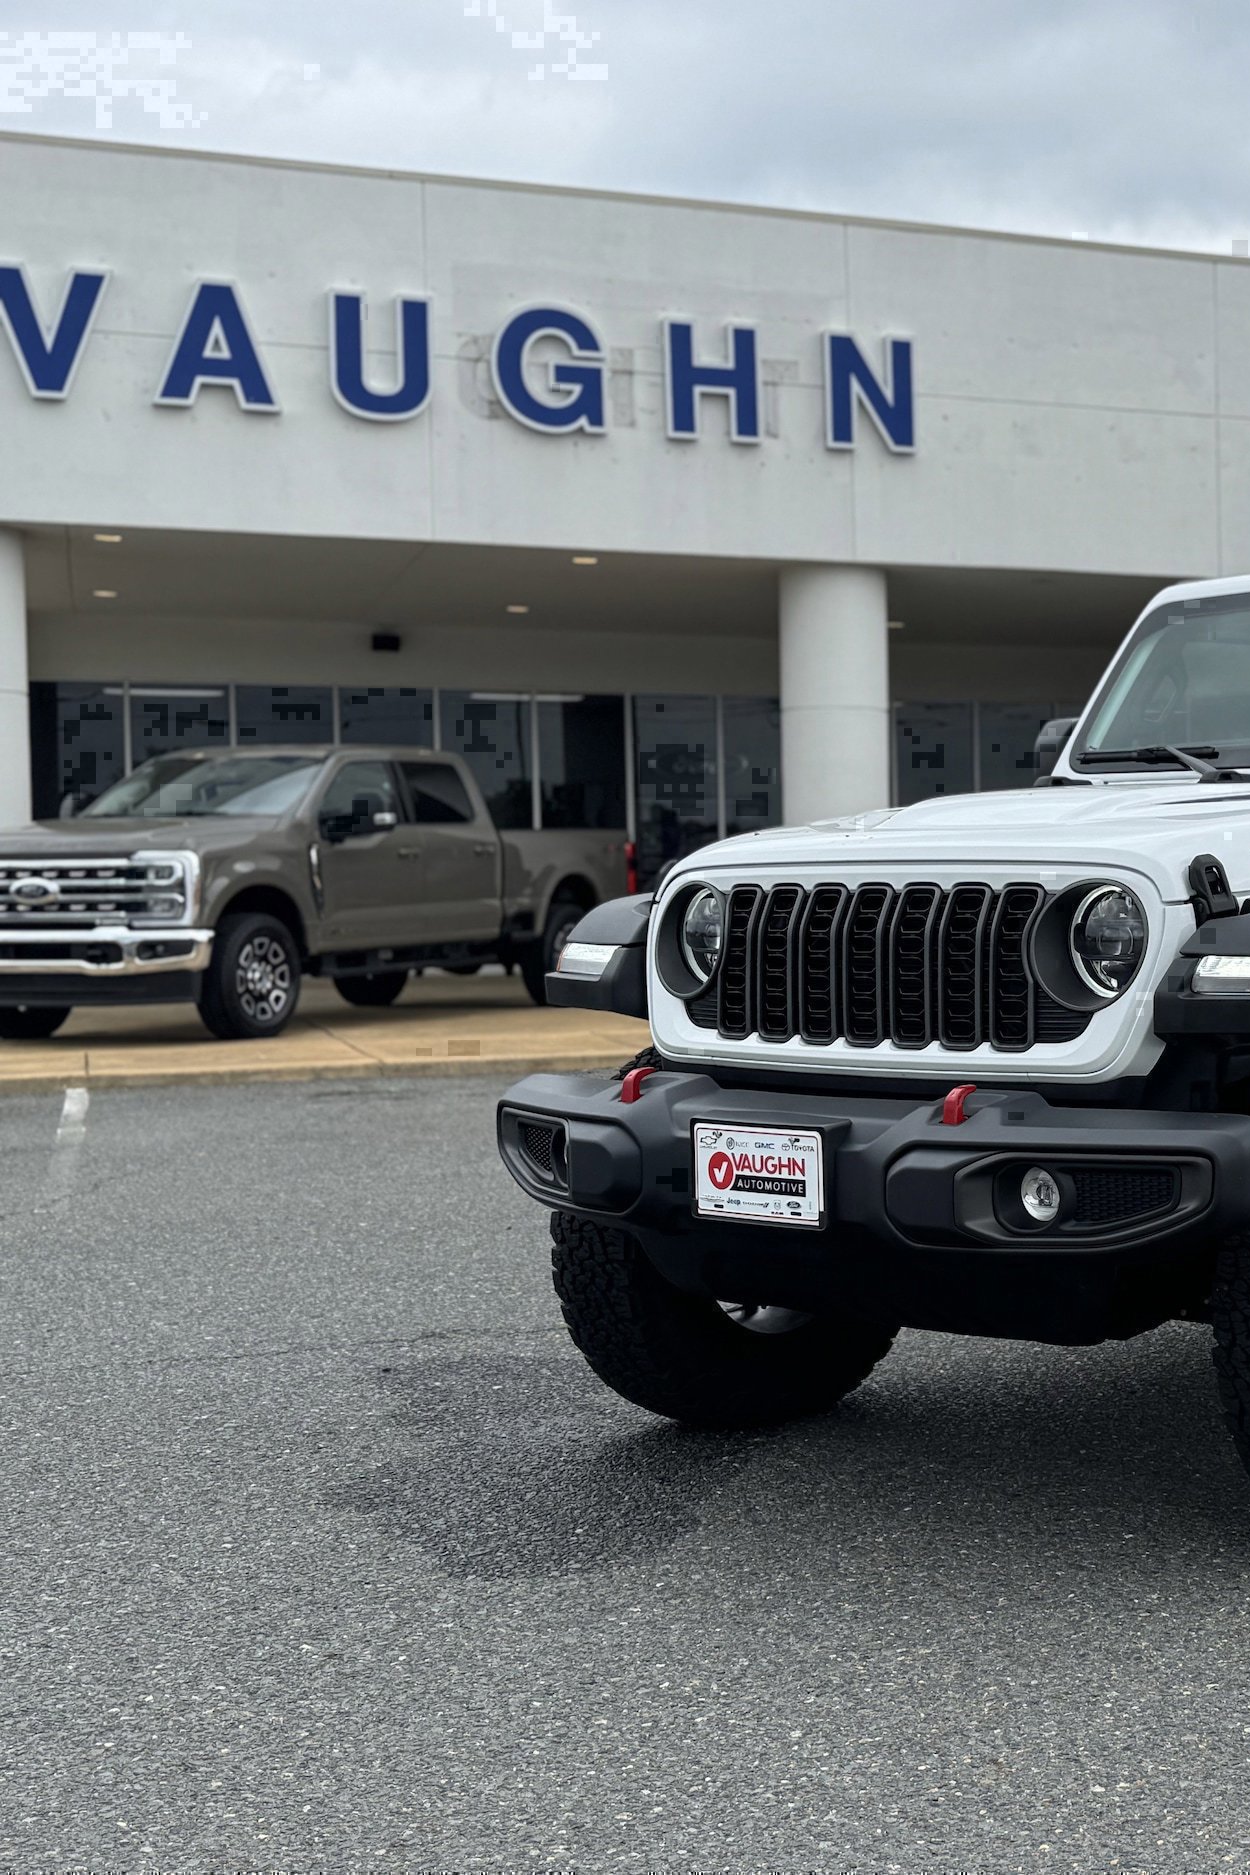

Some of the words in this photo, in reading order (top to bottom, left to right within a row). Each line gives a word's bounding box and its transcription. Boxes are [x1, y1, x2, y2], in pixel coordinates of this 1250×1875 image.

[0, 262, 918, 456] VAUGHN
[754, 1141, 775, 1149] GMC
[731, 1153, 805, 1176] VAUGHN
[737, 1179, 804, 1193] AUTOMOTIVE
[727, 1198, 741, 1206] Jeep
